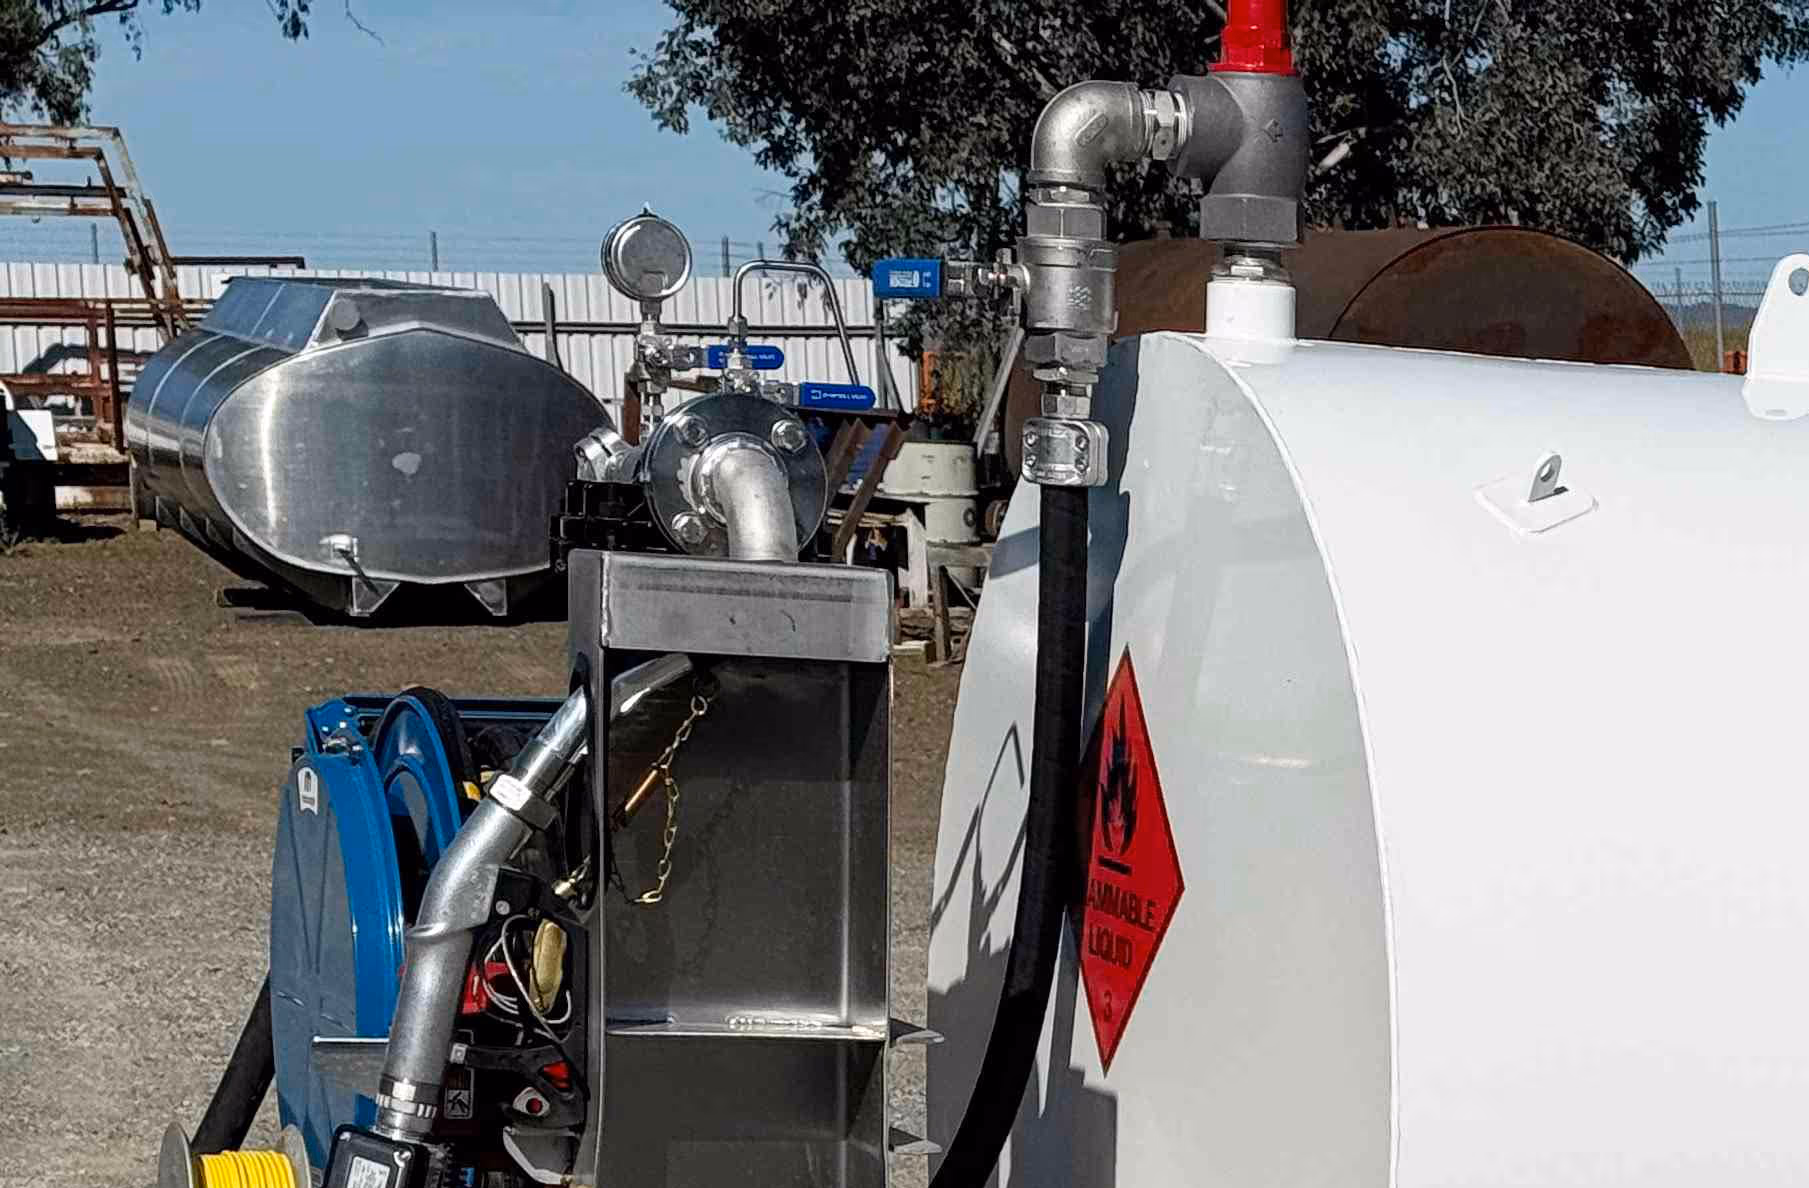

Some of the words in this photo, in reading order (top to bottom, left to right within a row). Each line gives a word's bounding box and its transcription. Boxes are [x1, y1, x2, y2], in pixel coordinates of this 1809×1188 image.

[1087, 878, 1157, 932] AMMABLE
[1088, 922, 1133, 967] LIQUID
[1103, 989, 1113, 1022] 3
